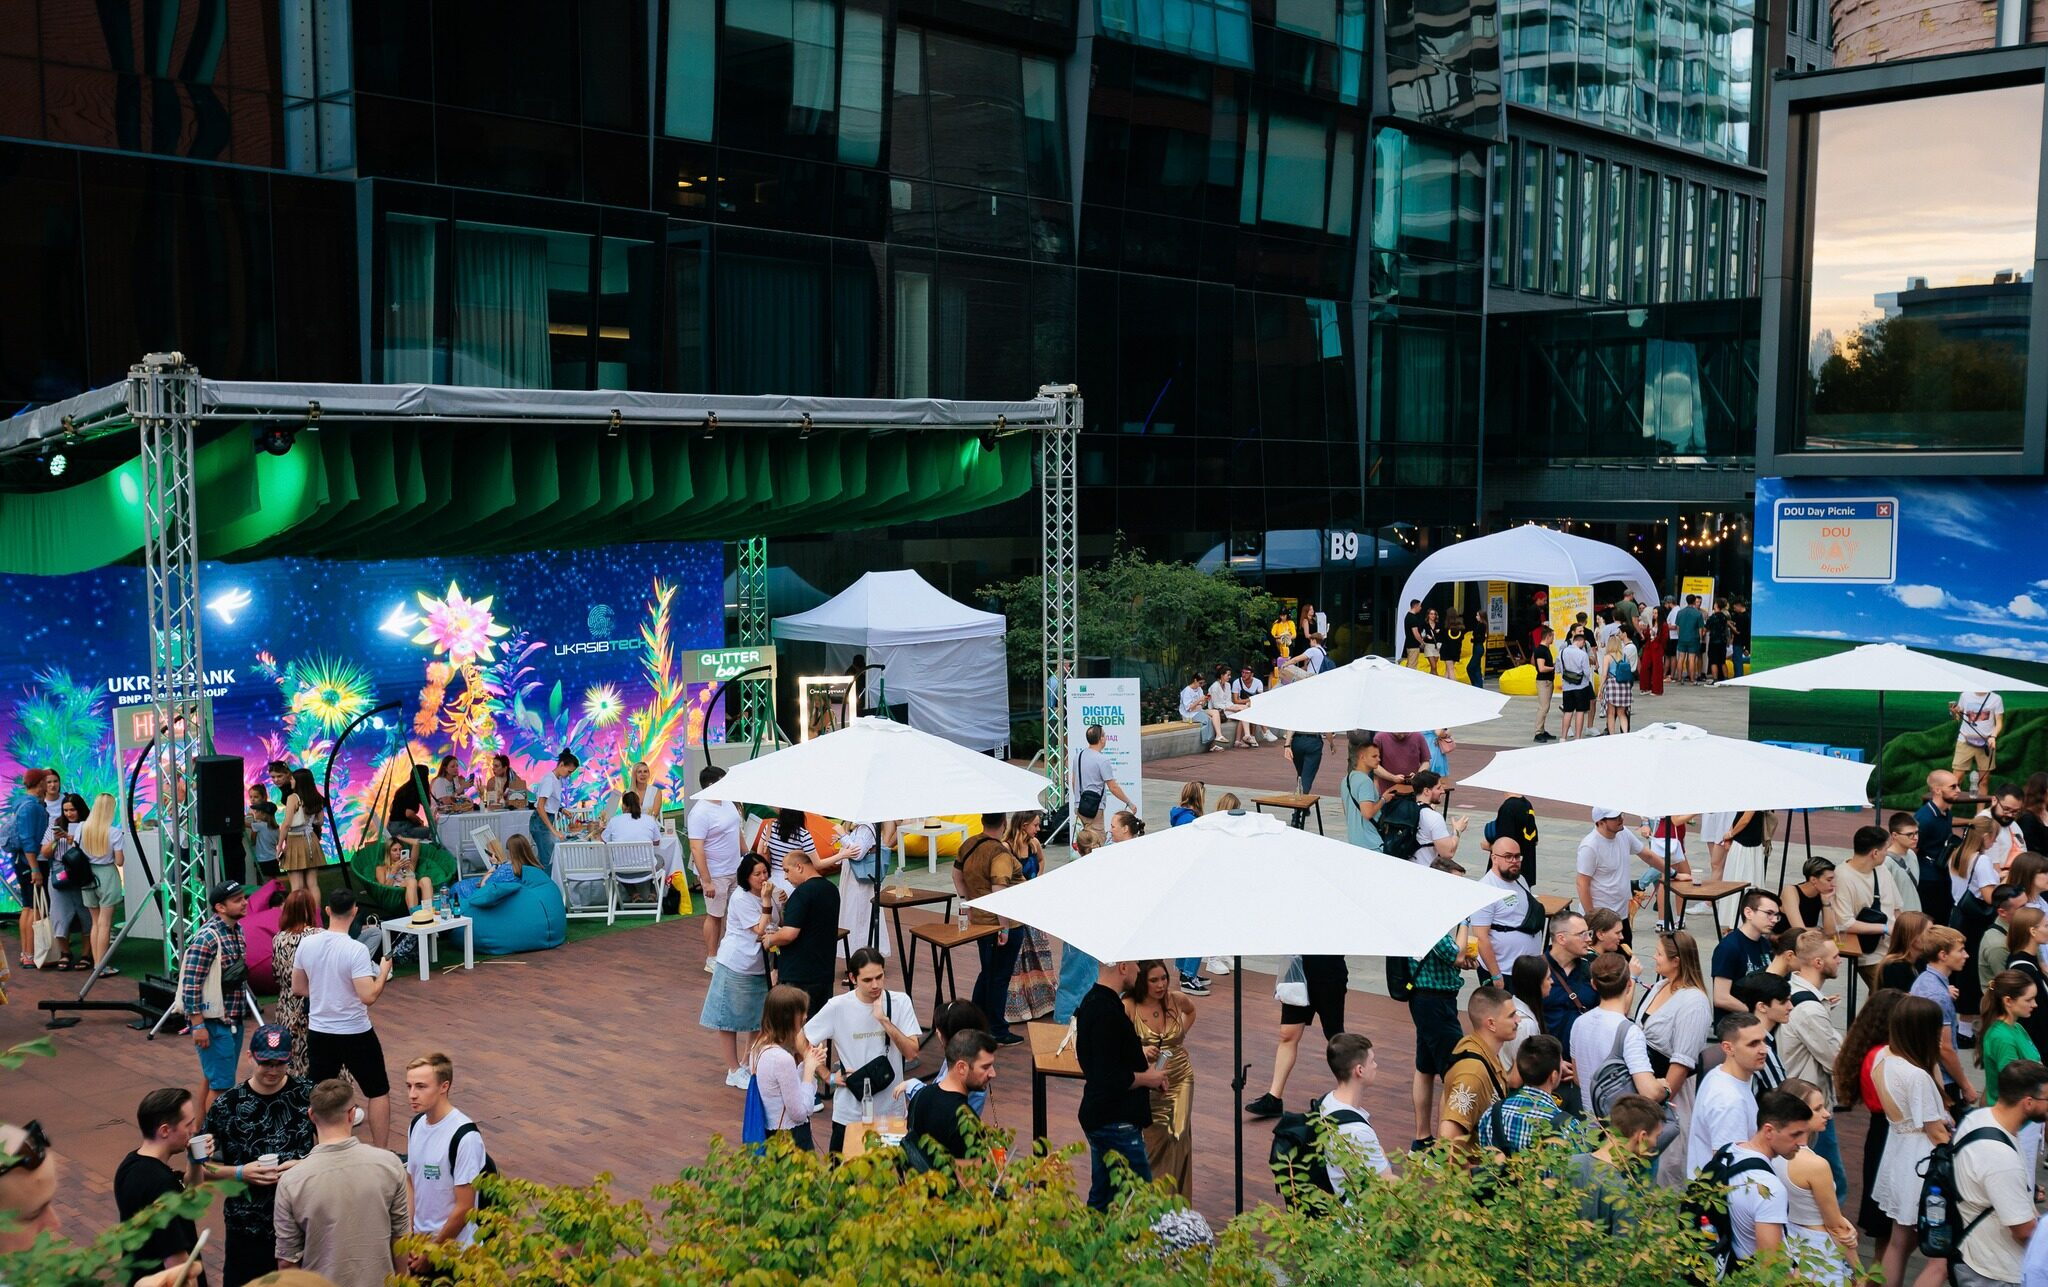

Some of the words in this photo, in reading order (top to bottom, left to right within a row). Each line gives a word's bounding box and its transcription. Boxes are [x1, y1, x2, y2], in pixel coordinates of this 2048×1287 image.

[1783, 507, 1805, 516] DOU
[1807, 507, 1825, 517] Day
[1827, 507, 1856, 516] Picnic
[1822, 527, 1851, 537] DOU
[1331, 532, 1359, 561] B9
[701, 651, 760, 666] GLITTER
[118, 694, 142, 705] BNP
[1082, 705, 1125, 716] DIGITAL
[1082, 715, 1125, 726] GARDEN
